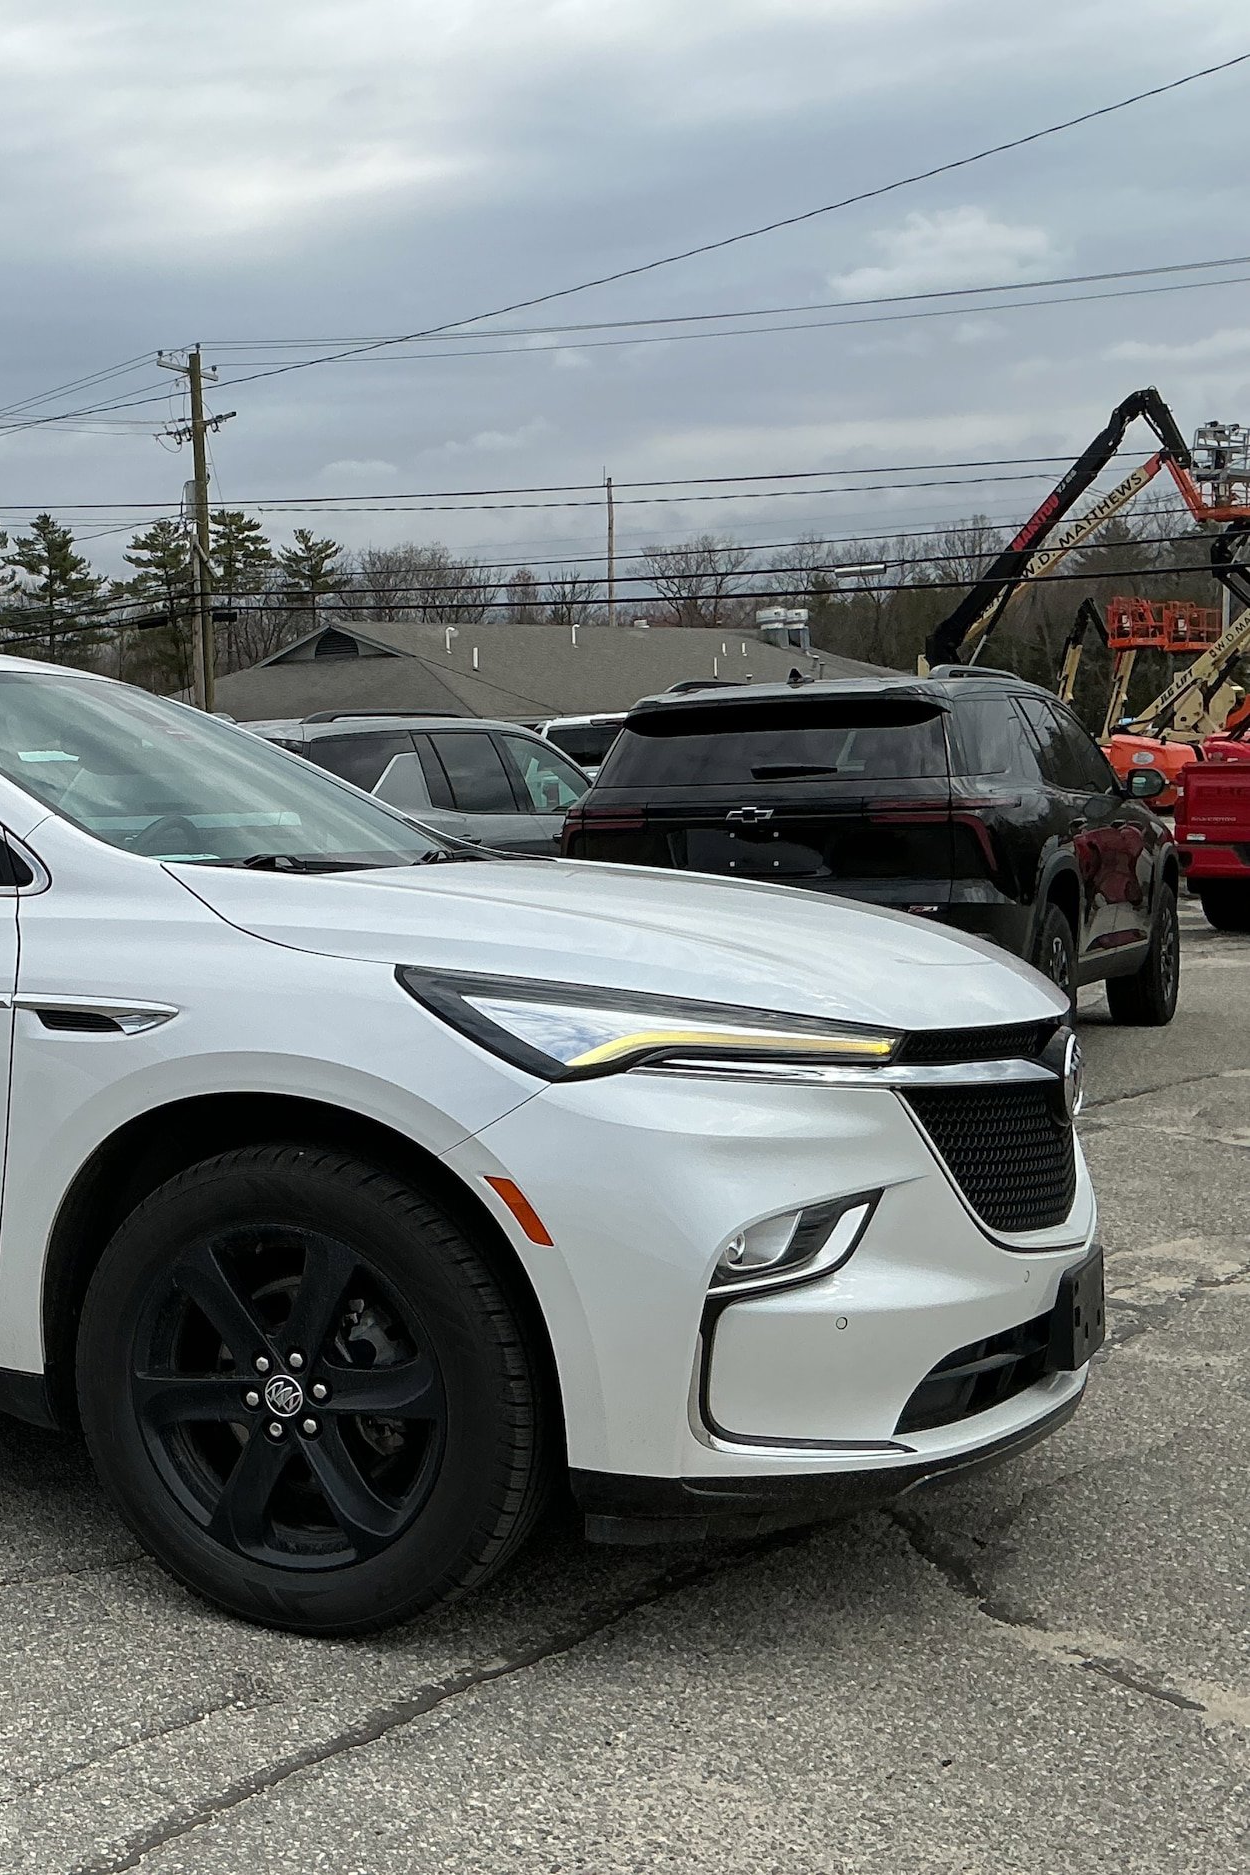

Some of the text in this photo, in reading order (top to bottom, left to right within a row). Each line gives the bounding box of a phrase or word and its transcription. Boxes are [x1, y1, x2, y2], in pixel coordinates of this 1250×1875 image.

[1012, 494, 1059, 552] MANITOU
[1059, 473, 1142, 548] MATTHEWS
[1160, 668, 1193, 705] JLG LIFT
